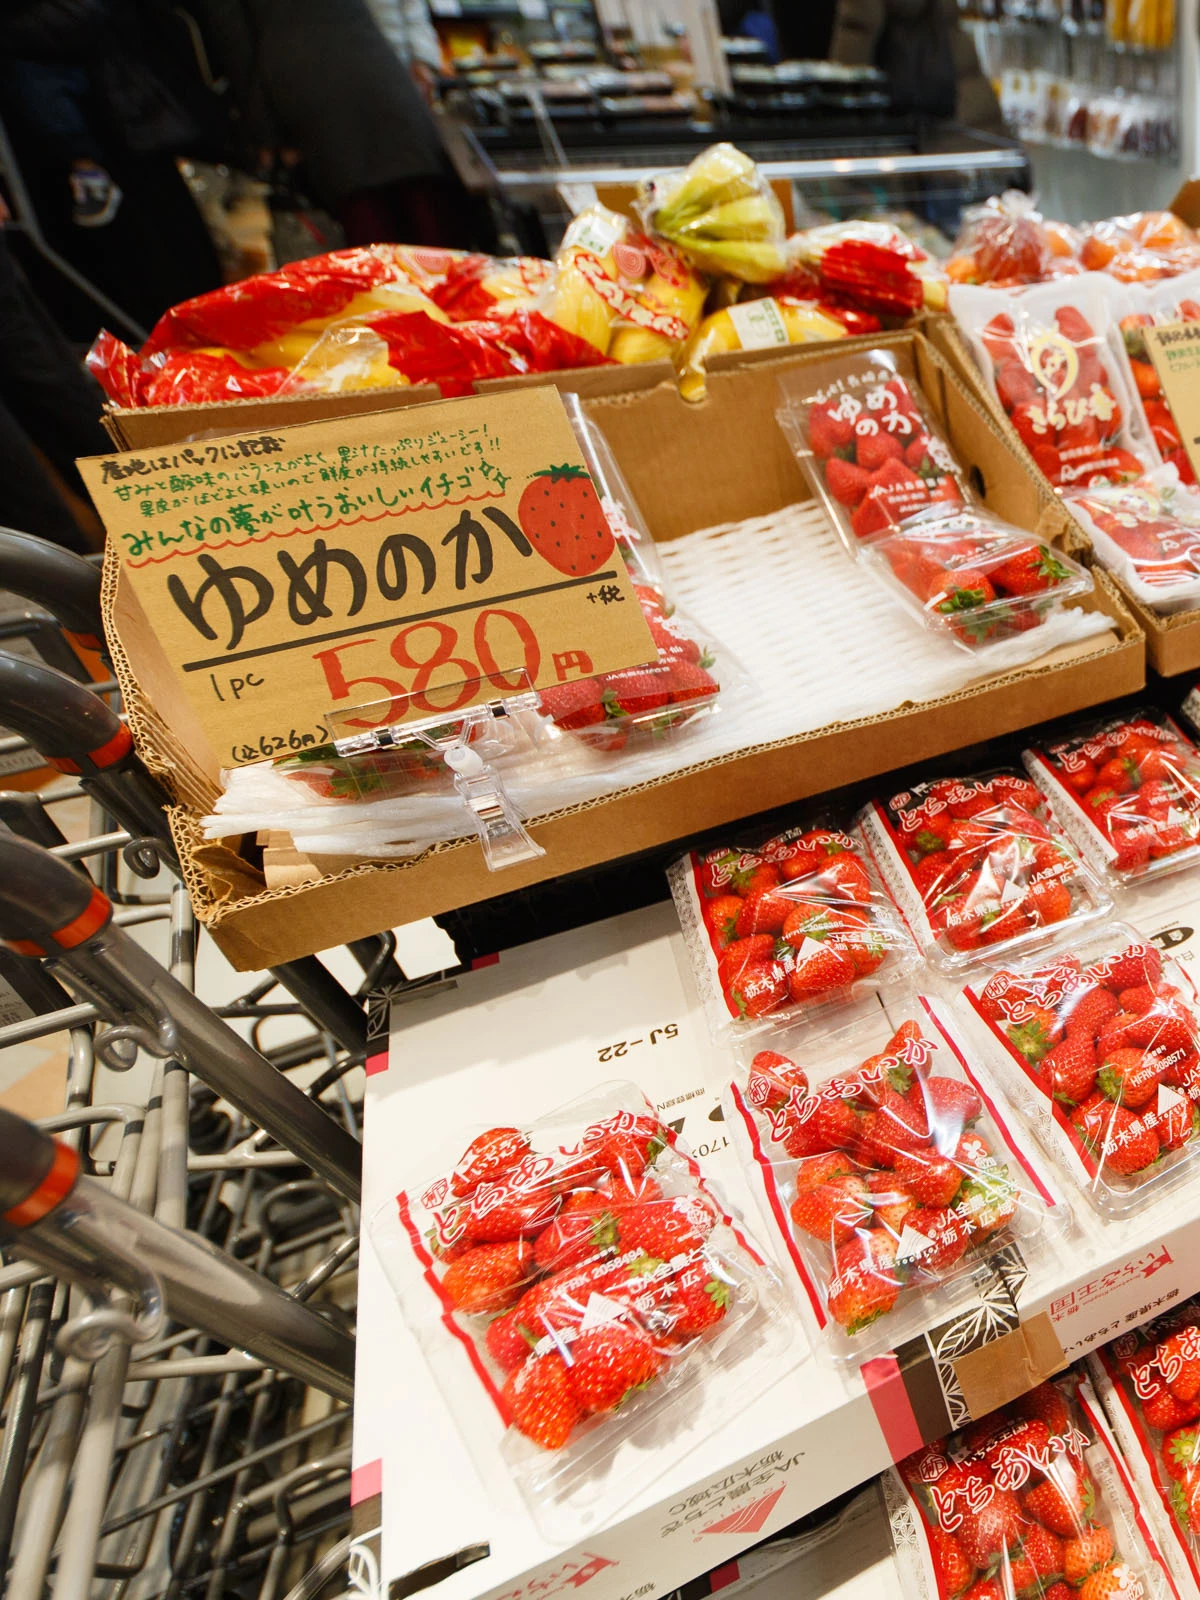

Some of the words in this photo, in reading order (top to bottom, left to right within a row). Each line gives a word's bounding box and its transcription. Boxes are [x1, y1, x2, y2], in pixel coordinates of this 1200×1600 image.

[166, 504, 534, 652] ゆめのか
[1000, 943, 1149, 1025] とちあいか
[763, 1037, 939, 1143] とちあいか
[1101, 1110, 1160, 1157] 栃木県産
[659, 1450, 807, 1538] JA全農とちぎ
[929, 1420, 1091, 1533] とちあいか
